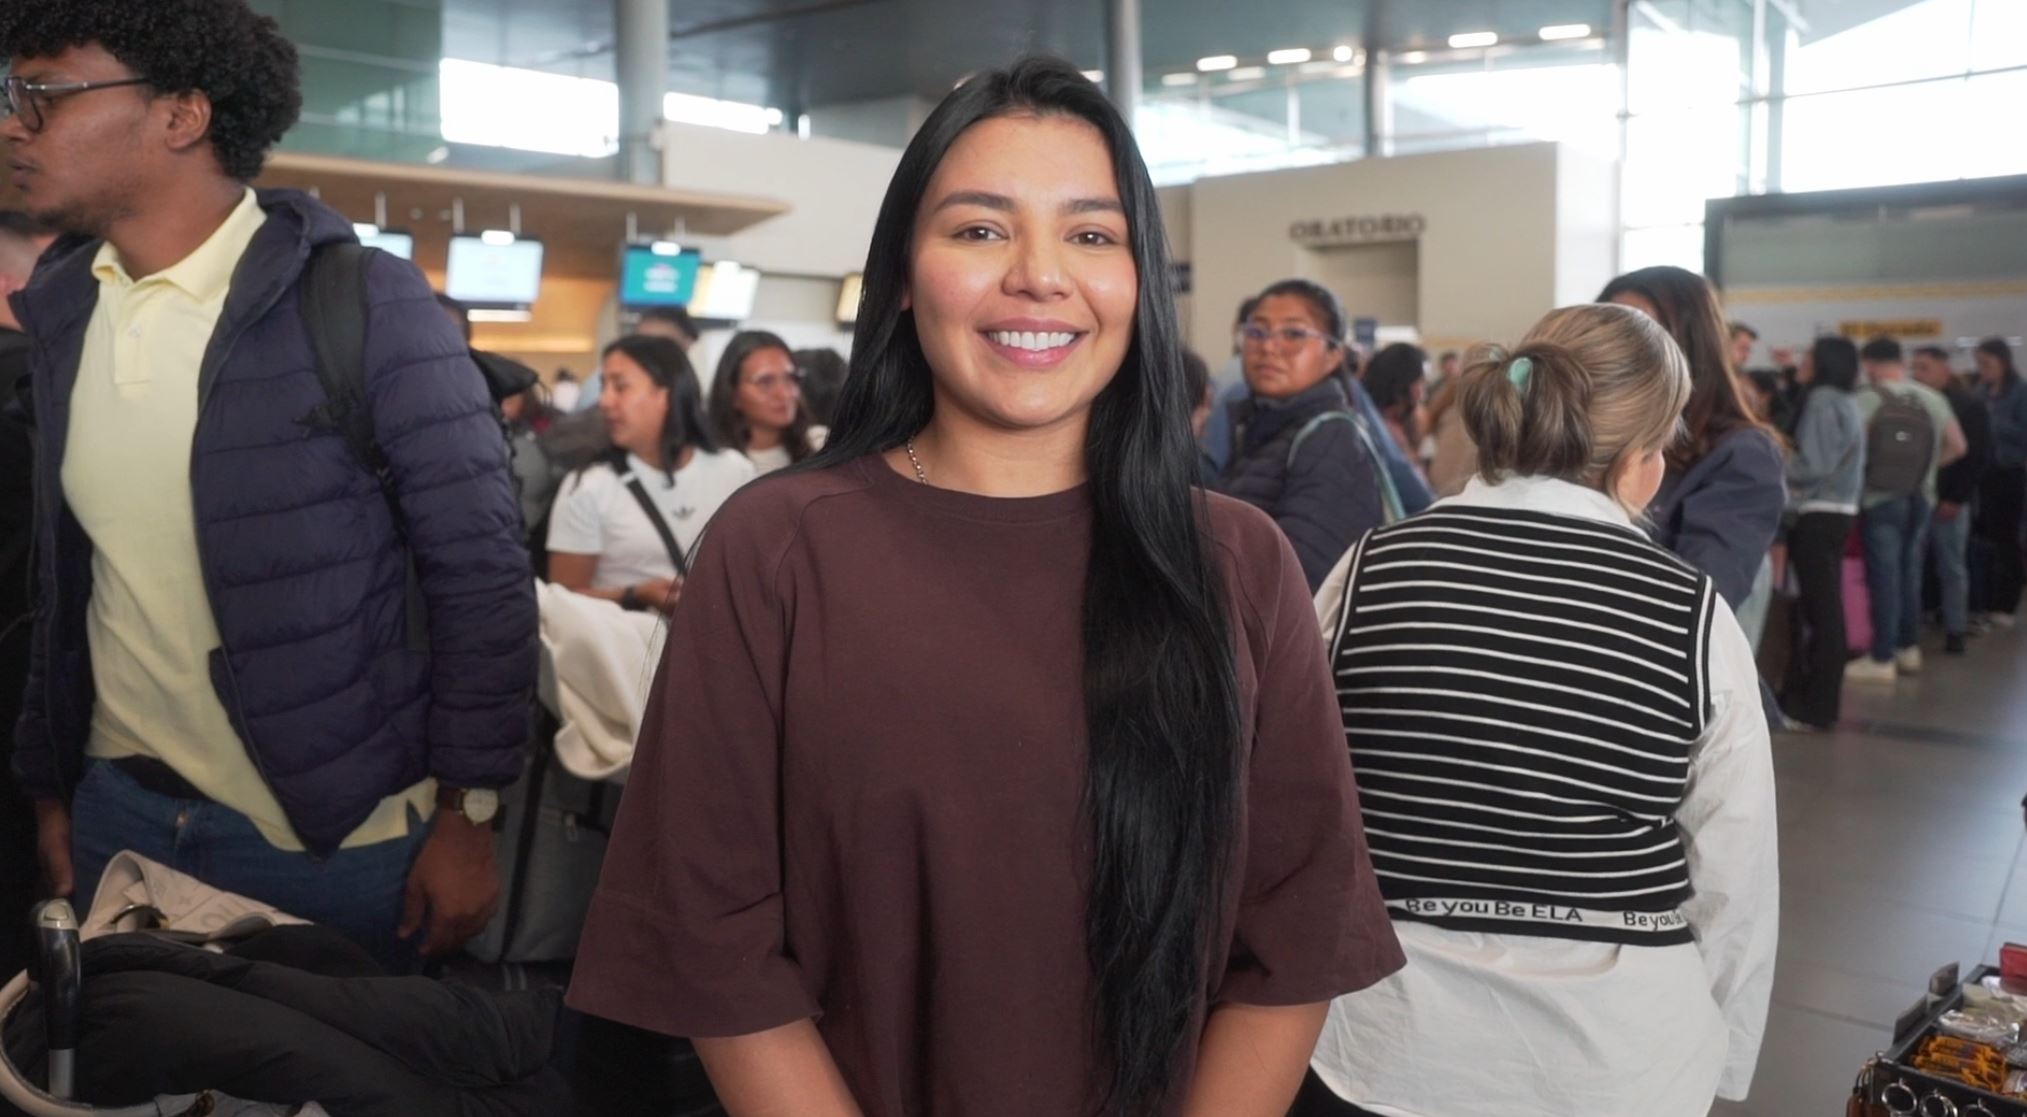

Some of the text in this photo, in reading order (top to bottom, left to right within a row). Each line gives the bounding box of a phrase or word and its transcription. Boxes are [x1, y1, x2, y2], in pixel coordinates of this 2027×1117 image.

[1288, 214, 1425, 239] ORATORIO
[1406, 899, 1583, 922] Be you Be ELA
[1623, 911, 1648, 926] Be
